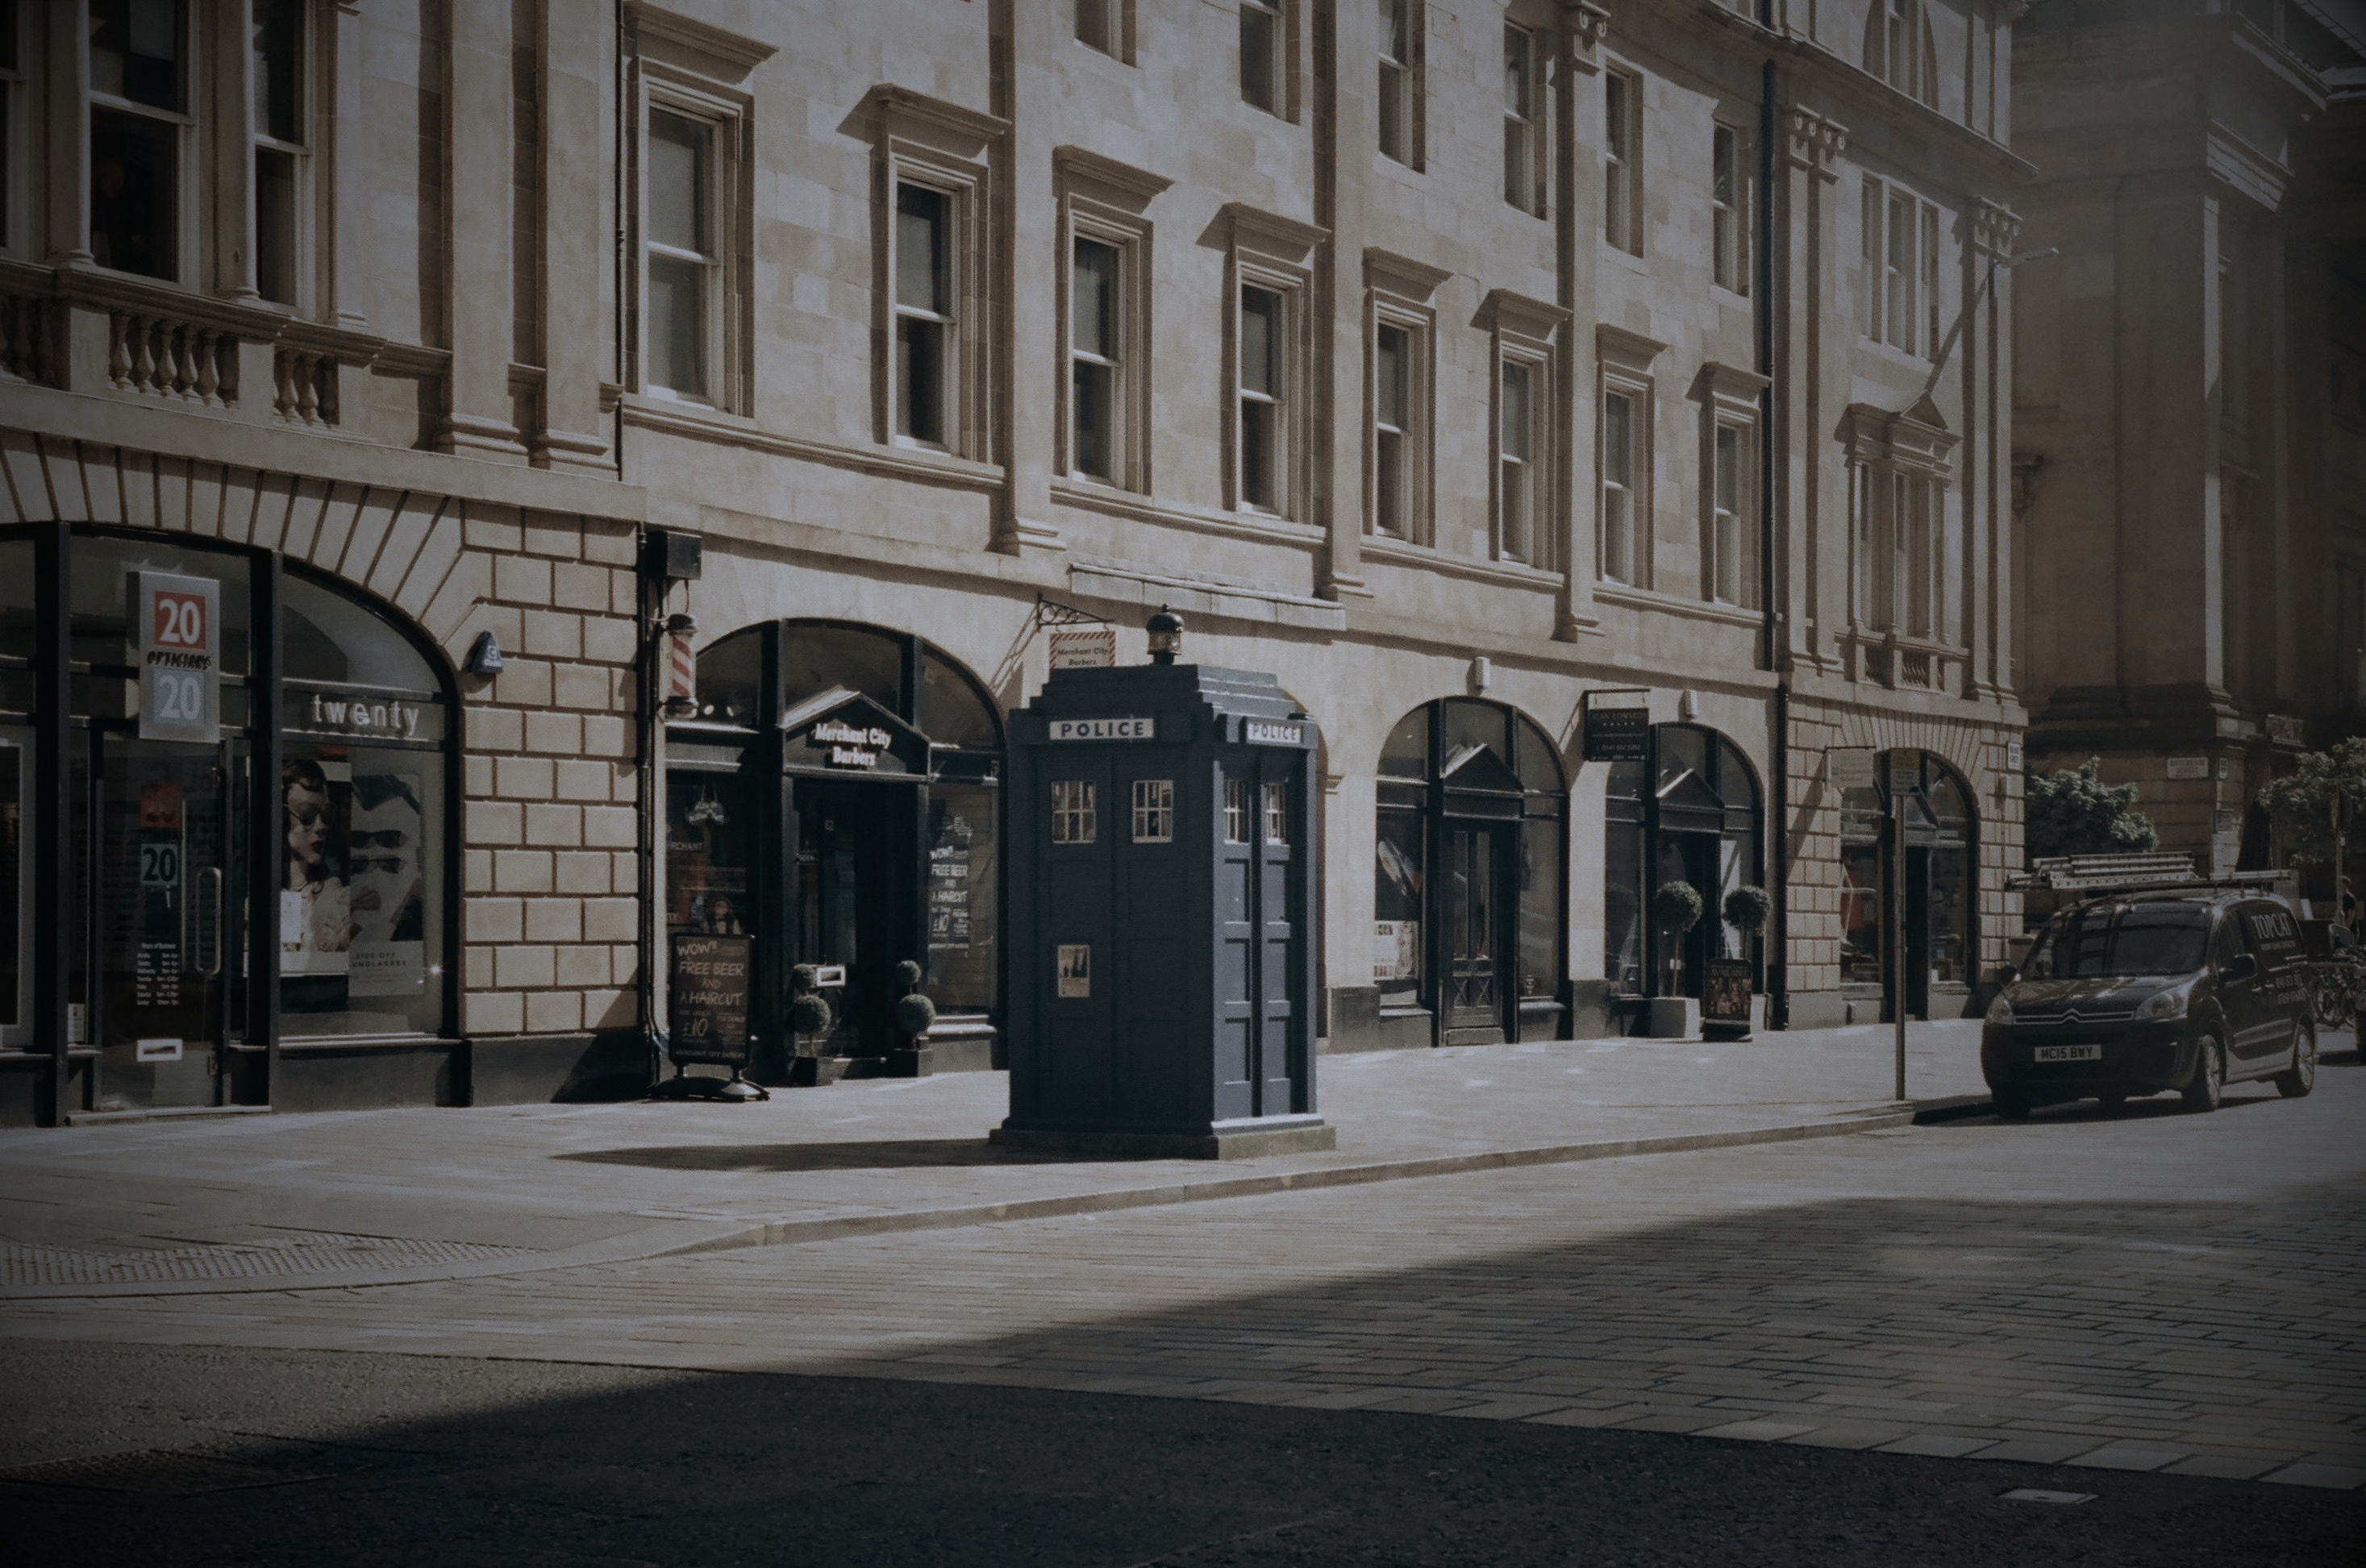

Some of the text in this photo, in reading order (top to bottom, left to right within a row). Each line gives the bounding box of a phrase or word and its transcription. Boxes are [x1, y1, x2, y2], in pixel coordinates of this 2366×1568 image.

[159, 598, 201, 645] 20
[160, 674, 202, 720] 20
[310, 694, 419, 735] twenty
[814, 723, 892, 750] Merchant City
[1061, 722, 1143, 737] POLICE
[1253, 723, 1296, 740] POLICE
[832, 746, 876, 765] Barbers
[144, 847, 176, 882] 20
[2251, 913, 2292, 939] TOPCAT
[679, 961, 744, 976] FREE BEER
[702, 977, 721, 989] AND
[681, 992, 744, 1006] A HAIRCUT
[684, 1017, 708, 1037] £10
